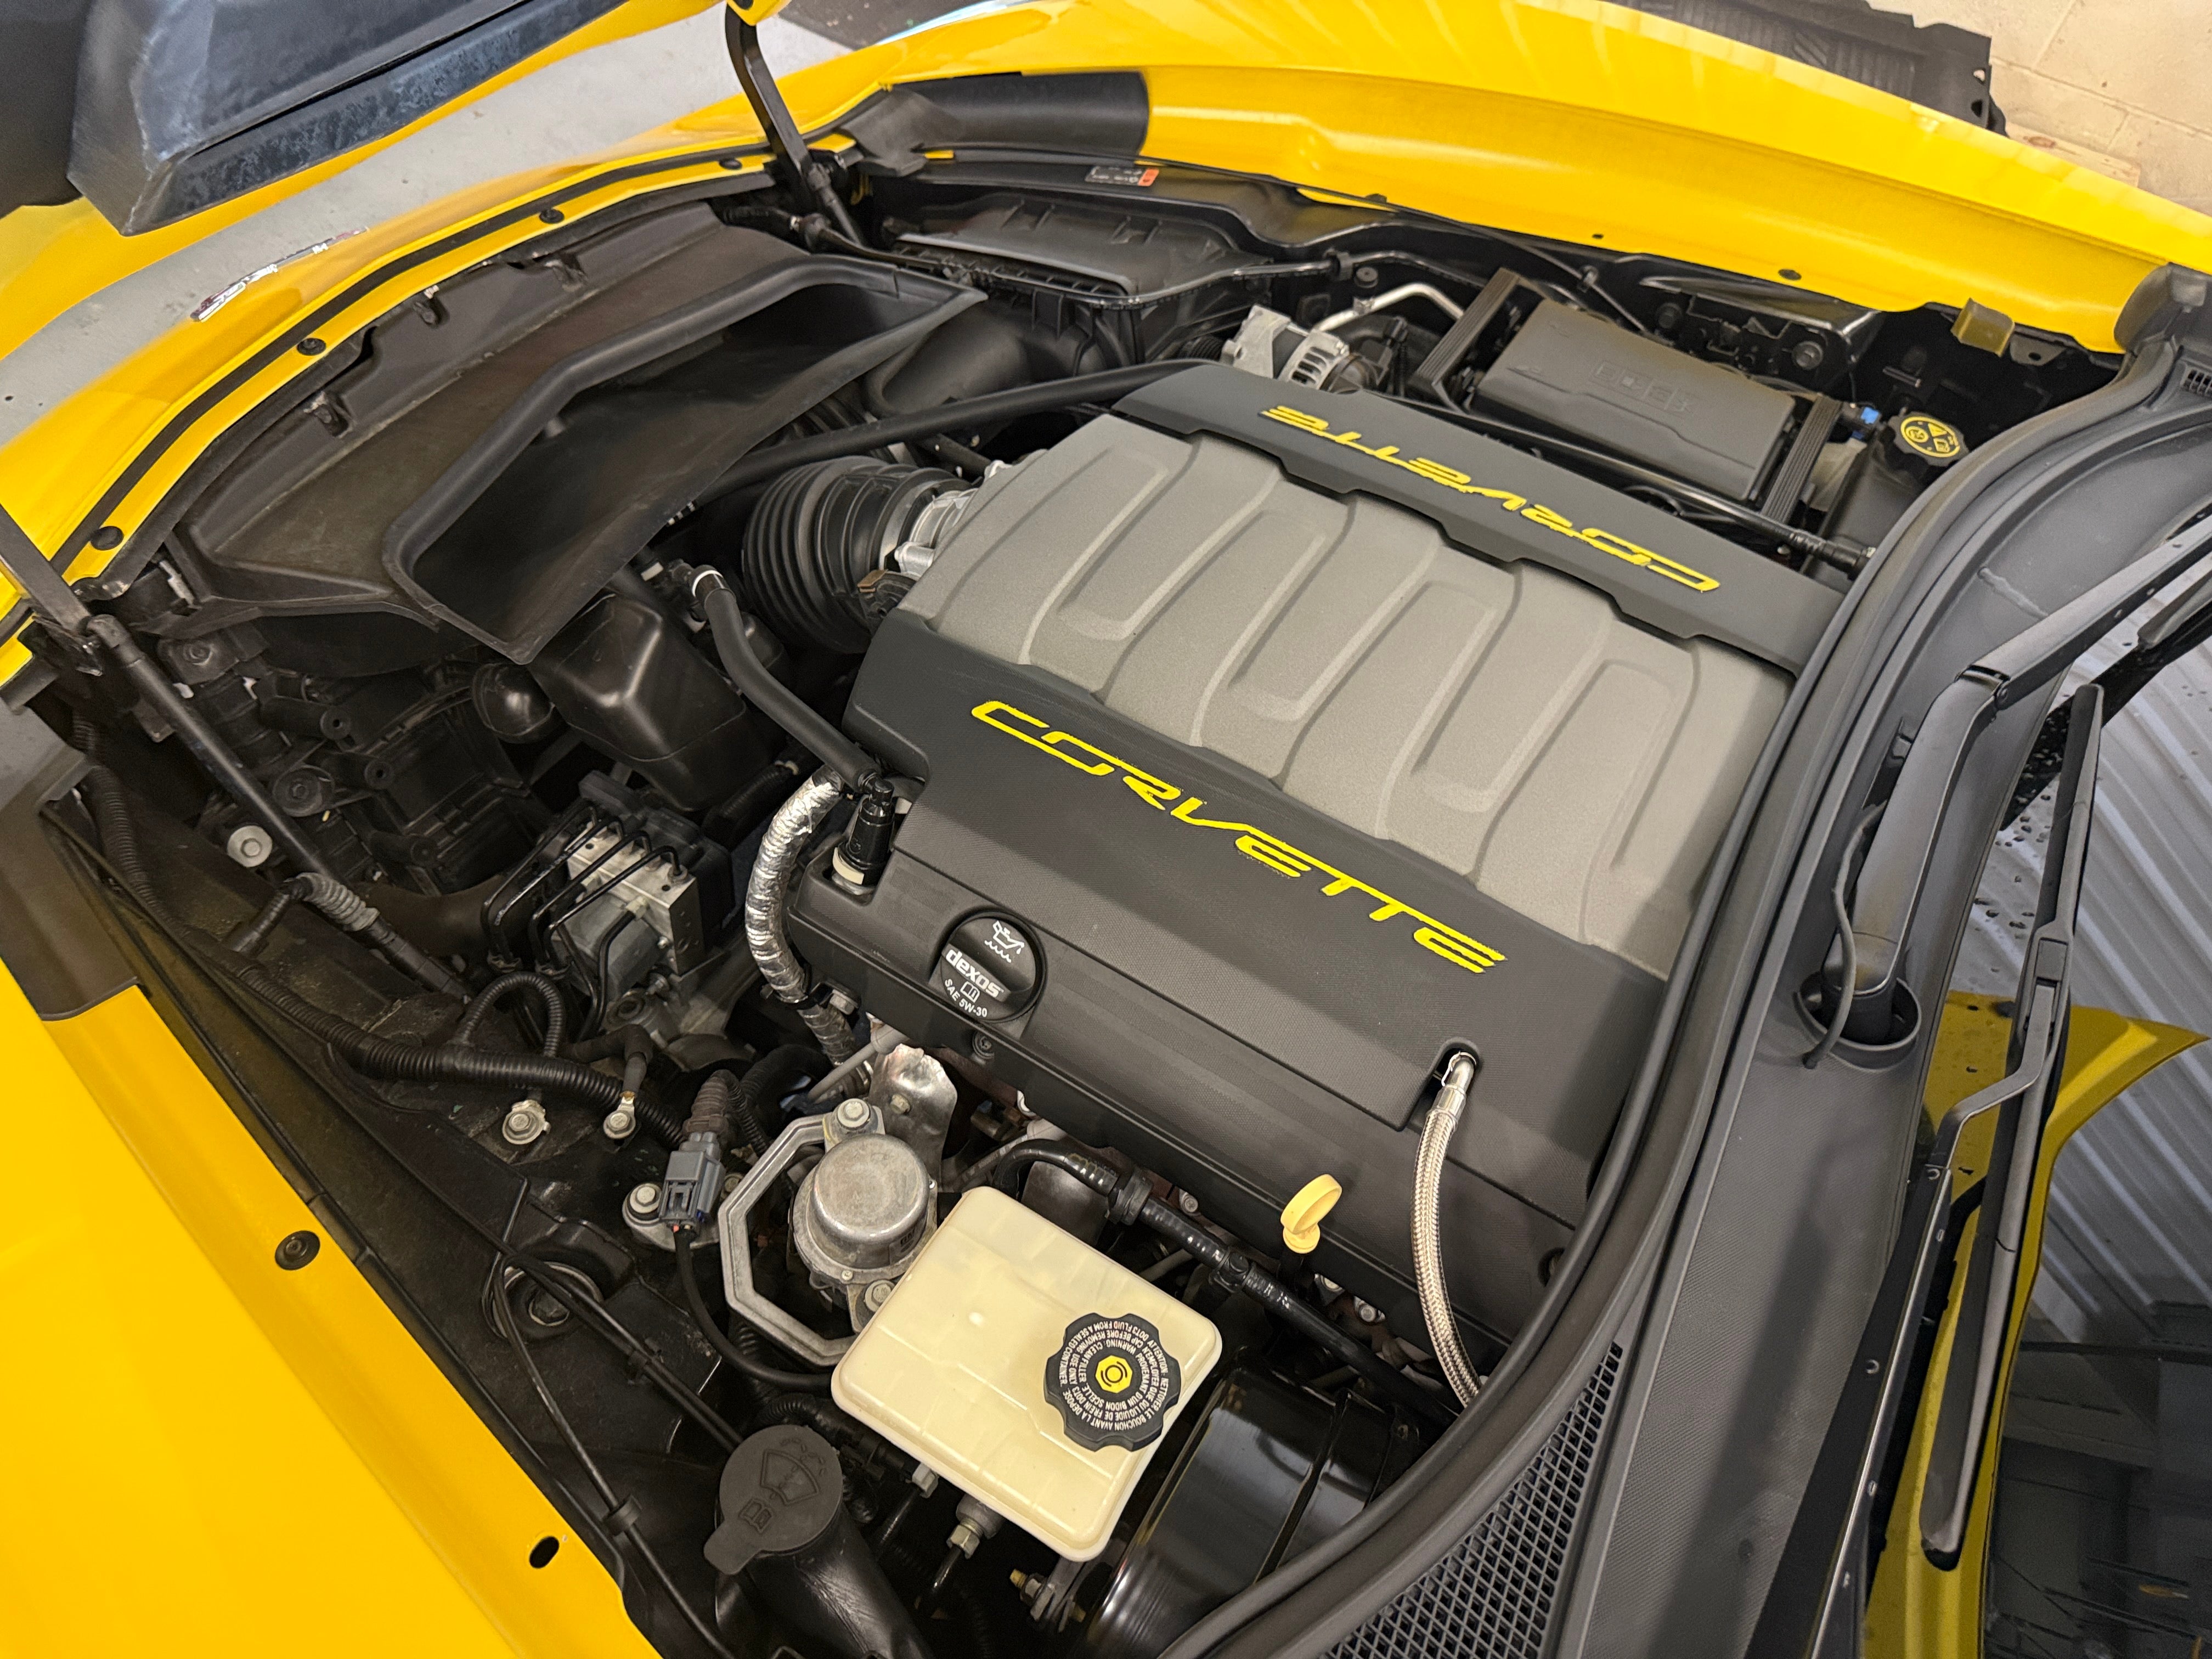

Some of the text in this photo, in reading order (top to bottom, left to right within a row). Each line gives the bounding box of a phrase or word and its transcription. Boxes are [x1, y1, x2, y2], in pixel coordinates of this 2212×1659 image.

[1259, 406, 1719, 592] CORVETTE
[972, 701, 1506, 973] CORVETTE
[945, 949, 1002, 998] dexos
[945, 978, 988, 1018] SAE 5W-30
[1093, 1321, 1112, 1331] FROM
[1114, 1321, 1132, 1332] FLUID
[1132, 1327, 1149, 1341] DOT3
[1069, 1328, 1089, 1348] SEALED
[1107, 1330, 1132, 1341] BEFORE
[1131, 1337, 1143, 1348] CAP
[1084, 1342, 1103, 1360] CLEAN
[1070, 1353, 1080, 1368] USE
[1069, 1368, 1077, 1384] ONLY
[1079, 1358, 1088, 1383] FILLER
[1136, 1353, 1150, 1393] PROVENANT
[1072, 1386, 1086, 1404] DOT3
[1146, 1386, 1157, 1402] QUE
[1151, 1378, 1169, 1411] NETTOYER
[1084, 1401, 1103, 1418] FREIN
[1105, 1401, 1127, 1411] BIDON
[1139, 1399, 1149, 1410] DU
[1081, 1411, 1091, 1422] LA
[1104, 1411, 1113, 1421] DE
[1115, 1406, 1141, 1421] LIQUIDE
[1144, 1408, 1155, 1419] LE
[1091, 1417, 1113, 1430] AVANT
[1115, 1414, 1146, 1431] BOUCHON
